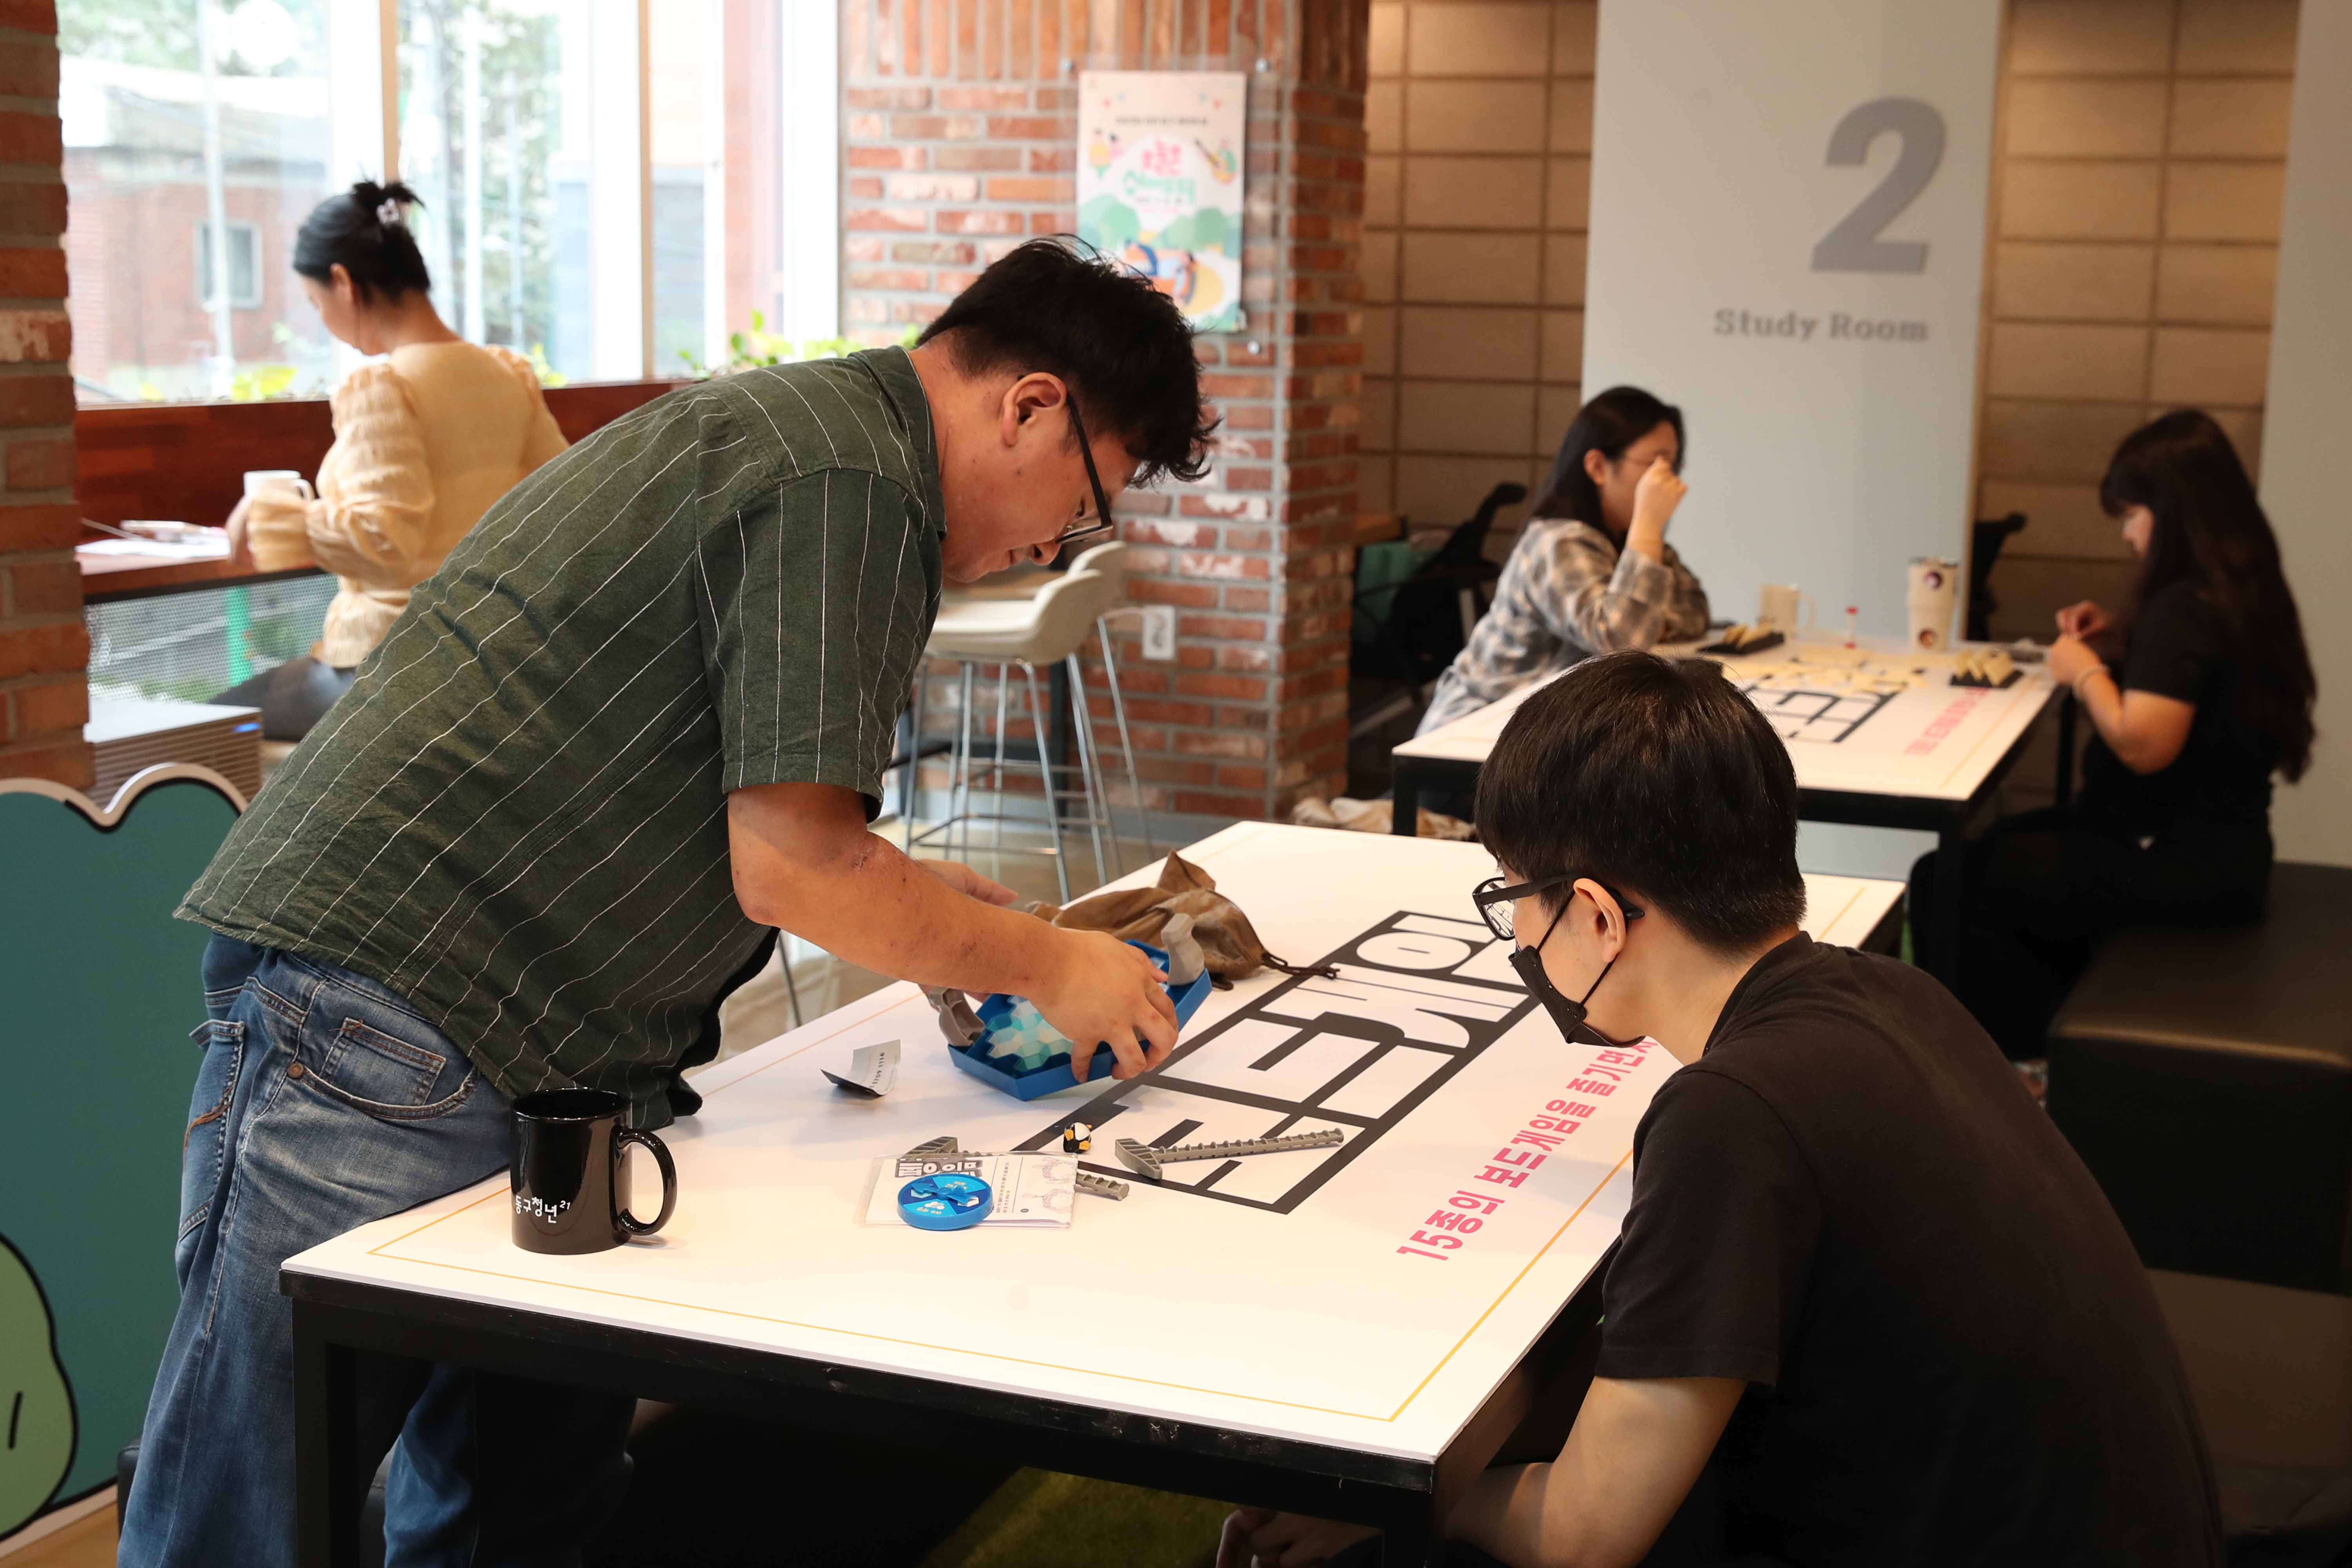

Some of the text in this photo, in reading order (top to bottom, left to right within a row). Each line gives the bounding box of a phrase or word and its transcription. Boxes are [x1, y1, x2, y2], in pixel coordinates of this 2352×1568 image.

[1810, 96, 1947, 274] 2
[1714, 309, 1929, 342] Study Room
[1396, 1190, 1505, 1261] 15종의
[1474, 1099, 1596, 1188] 보드게임을
